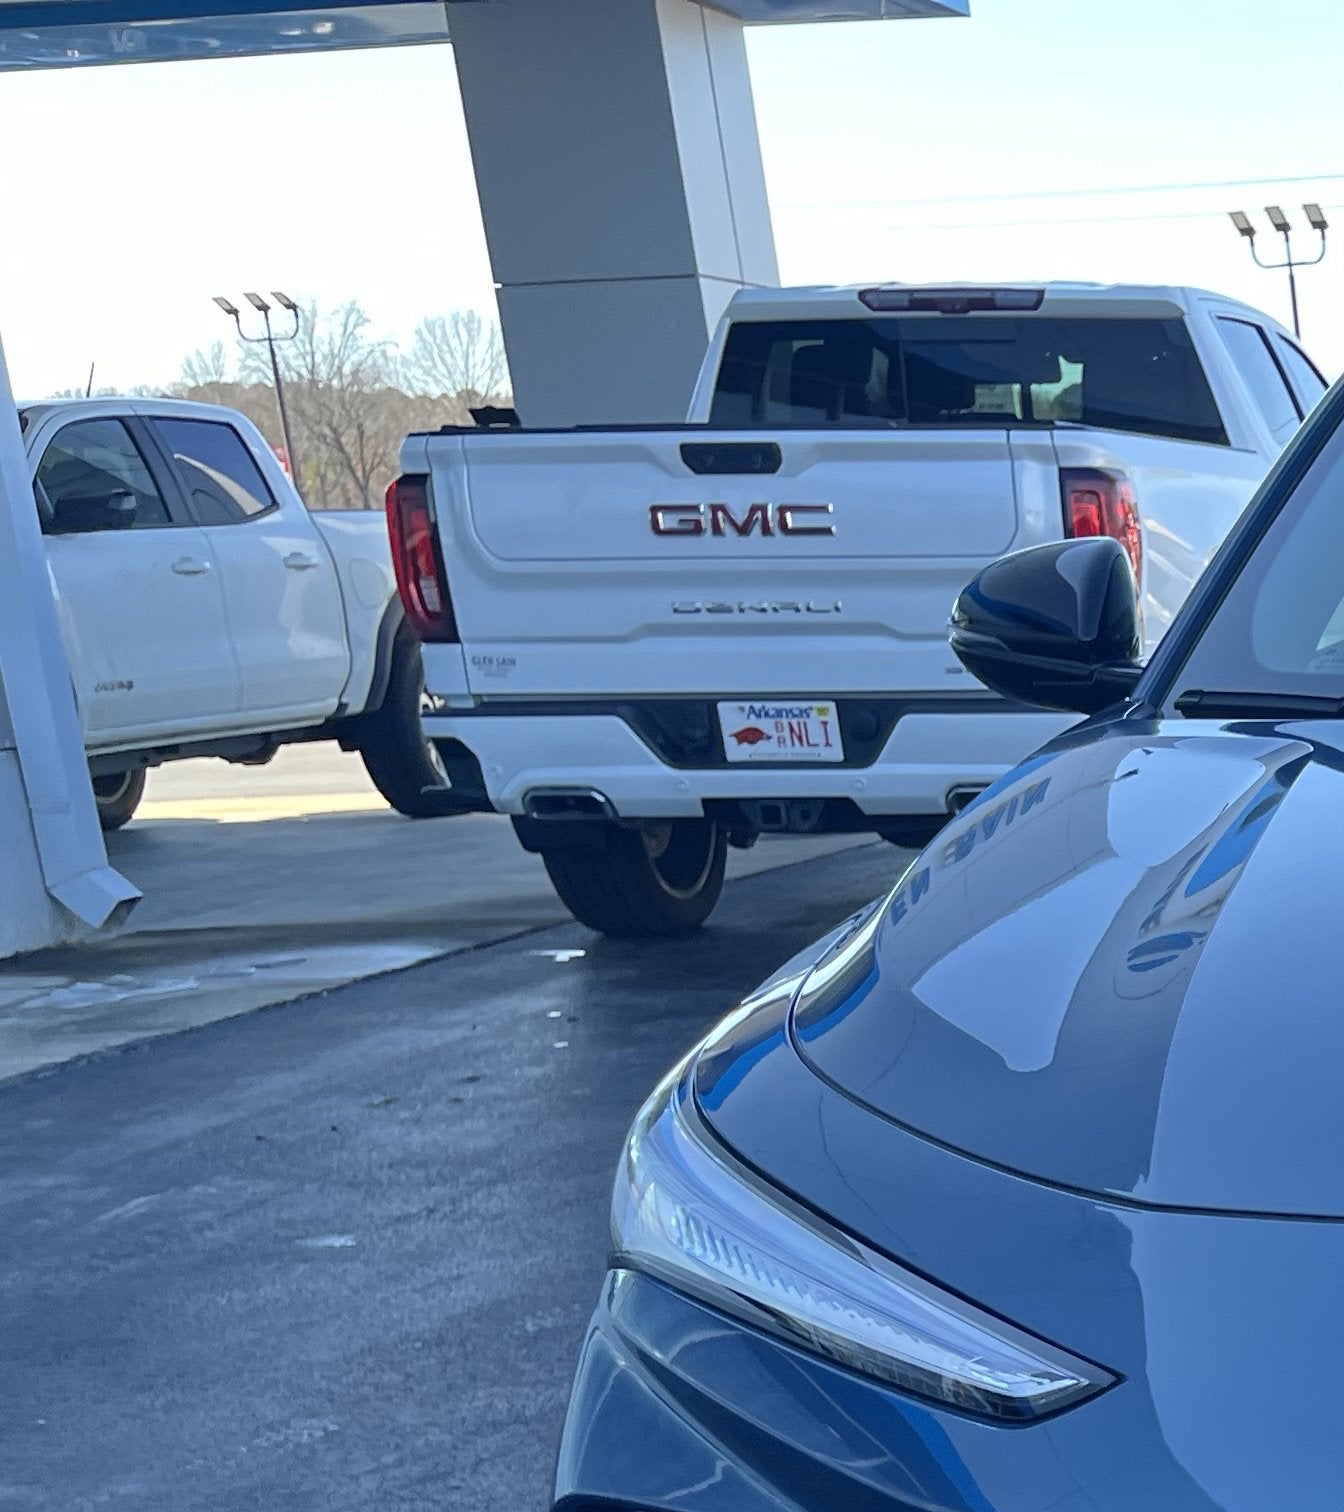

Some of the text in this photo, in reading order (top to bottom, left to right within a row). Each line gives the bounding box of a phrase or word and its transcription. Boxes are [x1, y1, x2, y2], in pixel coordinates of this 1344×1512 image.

[649, 502, 837, 537] GMC
[672, 600, 842, 614] DENALI
[746, 705, 813, 719] Arkansas
